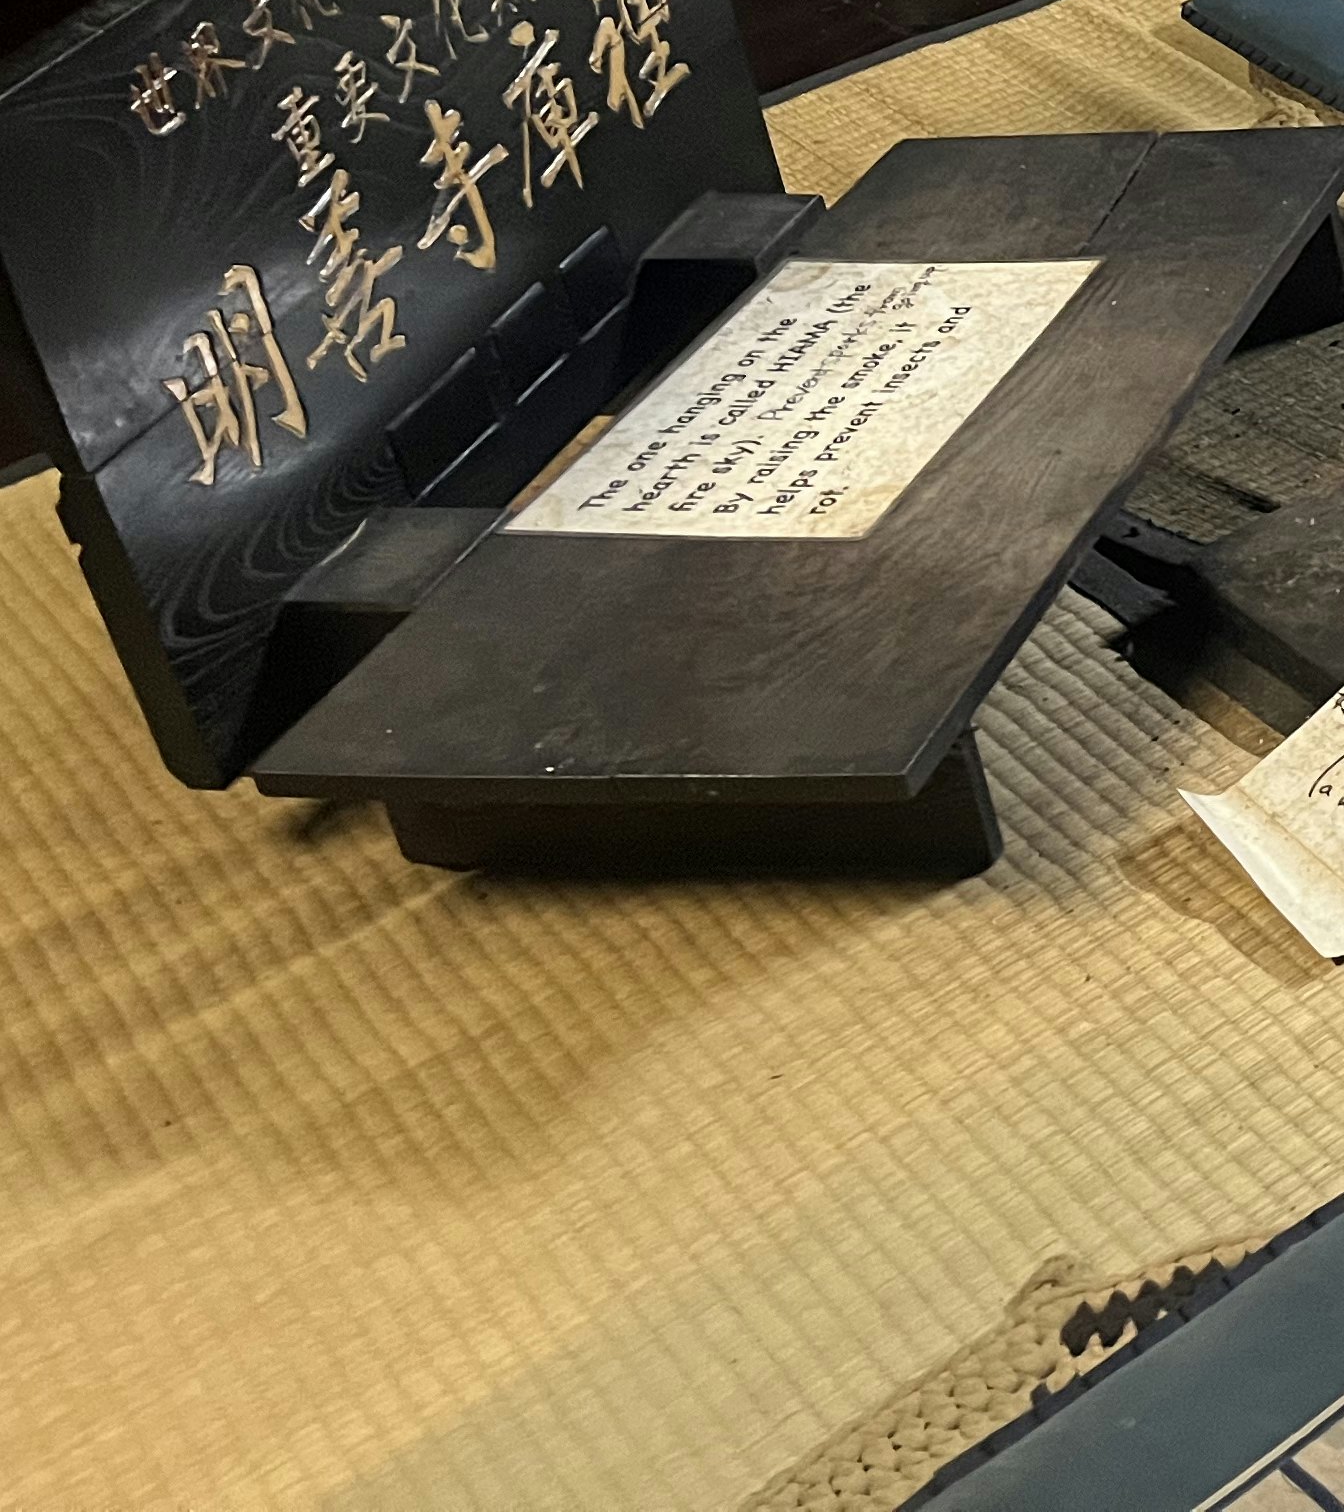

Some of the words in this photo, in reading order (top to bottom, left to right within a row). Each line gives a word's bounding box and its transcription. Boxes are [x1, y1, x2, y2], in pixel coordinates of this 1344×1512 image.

[576, 480, 629, 511] The
[626, 441, 668, 472] one
[657, 373, 747, 434] hanging
[737, 350, 766, 367] on
[756, 318, 798, 342] the
[621, 453, 702, 512] hearth
[699, 434, 721, 447] is
[718, 379, 776, 426] called
[771, 320, 839, 372] HIAMA
[827, 284, 872, 314] (the
[668, 482, 717, 512] fire
[711, 435, 765, 474] sky).
[712, 492, 755, 514] By
[746, 430, 820, 485] raising
[805, 396, 846, 422] the
[840, 338, 904, 389] smoke,
[890, 321, 918, 332] it
[756, 469, 819, 515] helps
[815, 401, 884, 462] prevent
[878, 340, 942, 393] insects
[936, 306, 973, 334] and
[807, 486, 850, 515] rot.
